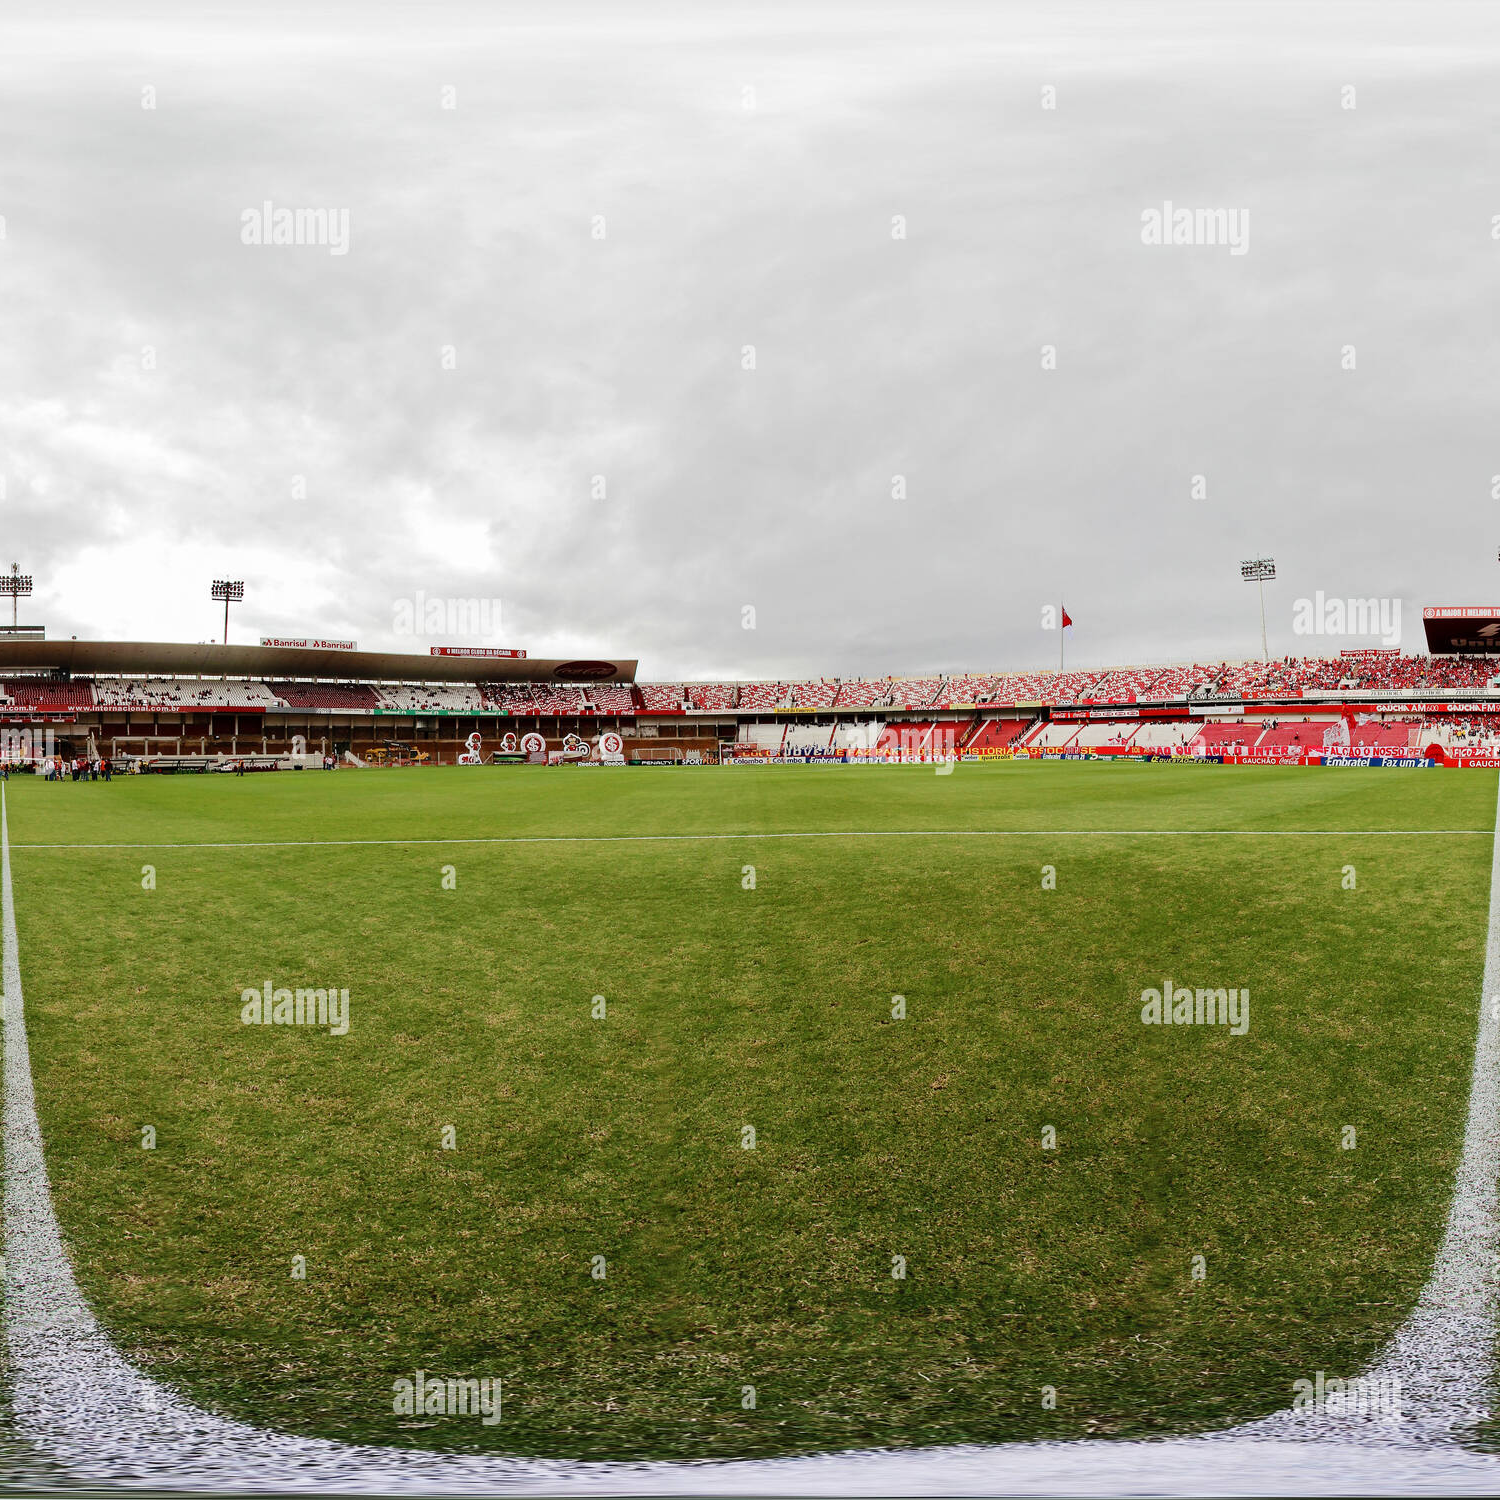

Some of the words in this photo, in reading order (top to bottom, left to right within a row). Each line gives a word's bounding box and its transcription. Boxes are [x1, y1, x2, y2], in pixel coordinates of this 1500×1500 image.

[1411, 704, 1426, 712] AM
[1482, 704, 1495, 712] FM
[1364, 747, 1370, 756] O
[1373, 747, 1404, 757] NOSSO
[1242, 757, 1276, 765] GAUCHÃO
[1325, 757, 1370, 767] Embratel
[1381, 758, 1397, 767] Faz
[1416, 758, 1429, 767] 21
